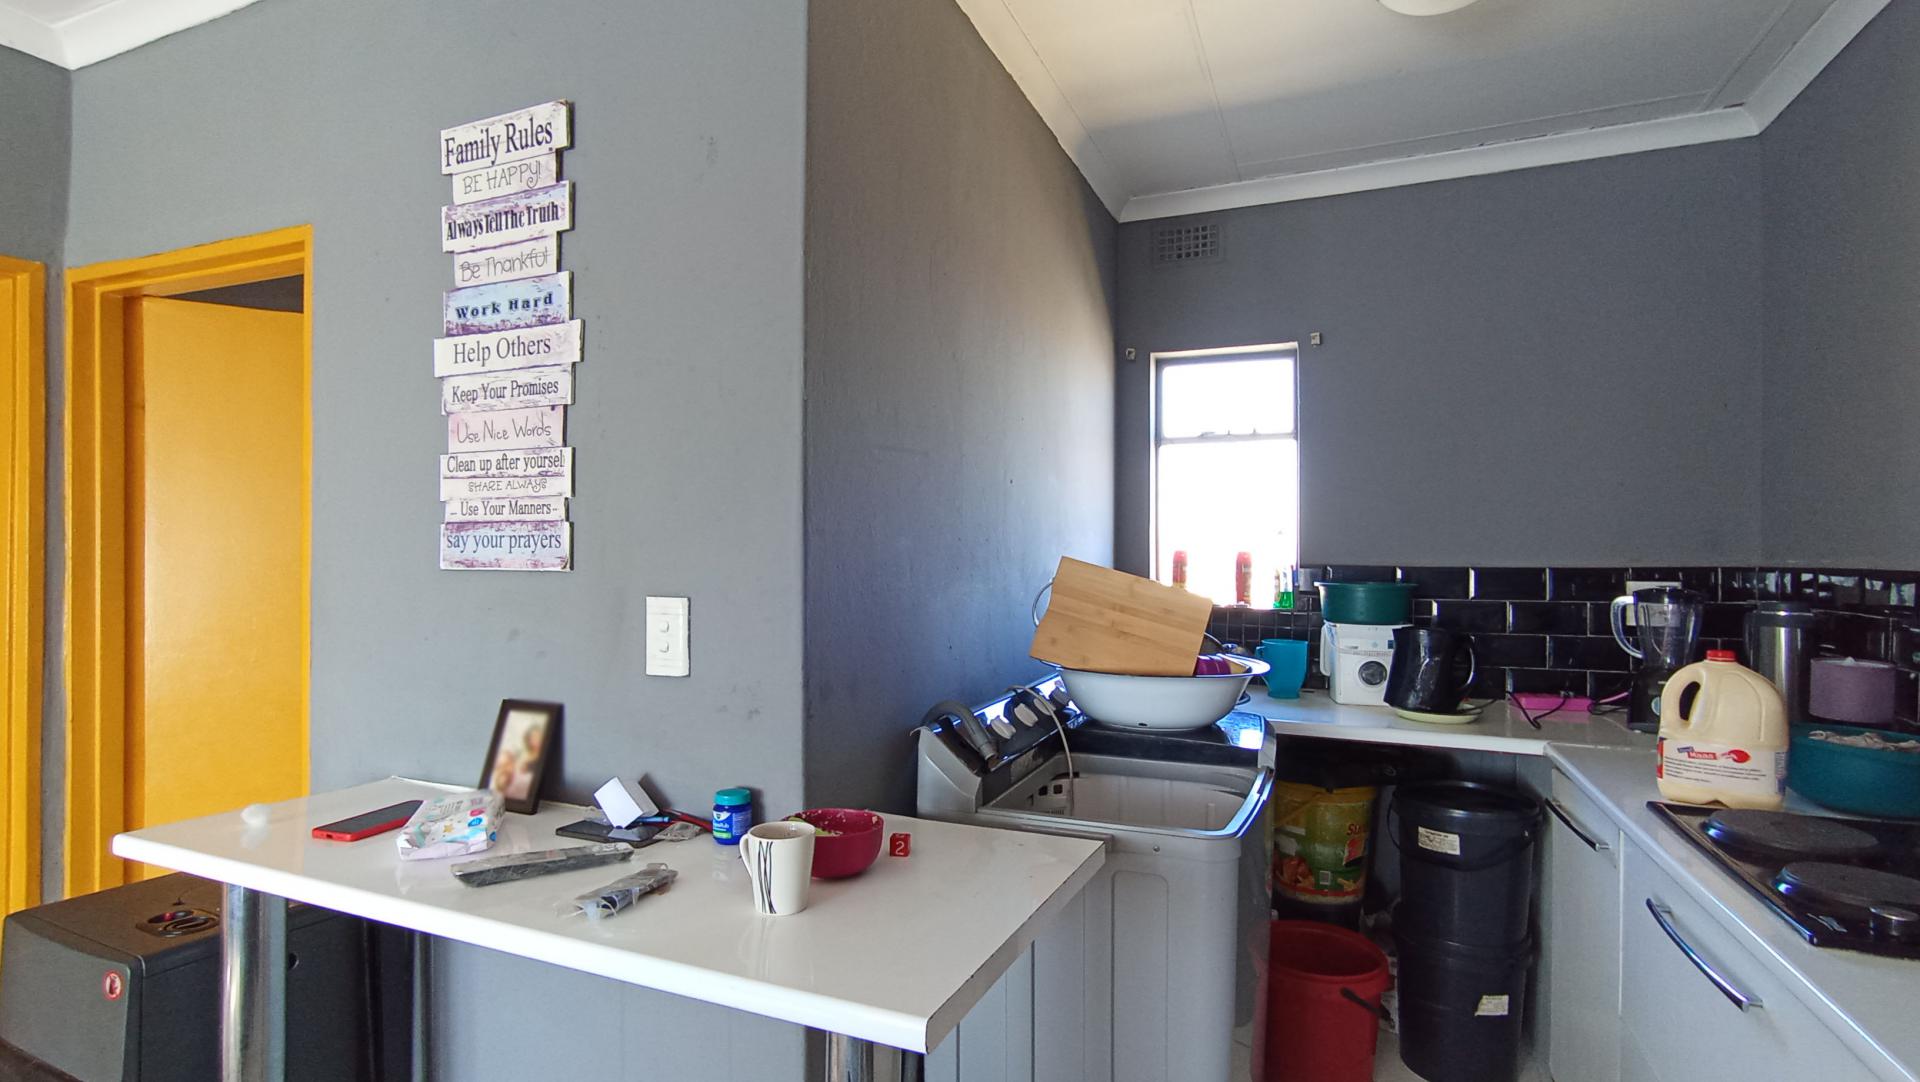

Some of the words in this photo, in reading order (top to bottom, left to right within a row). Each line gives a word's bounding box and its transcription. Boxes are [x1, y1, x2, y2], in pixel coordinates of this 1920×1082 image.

[445, 128, 501, 166] Family
[505, 117, 553, 153] Rules
[463, 173, 482, 194] BE
[486, 160, 541, 188] HAPPY!
[447, 218, 484, 240] Always
[484, 212, 502, 234] Tell
[503, 208, 525, 230] The
[526, 202, 560, 226] Truth
[460, 260, 481, 282] Be
[486, 246, 548, 276] Thankful
[455, 301, 501, 319] Work
[509, 293, 554, 311] Hard
[453, 341, 491, 367] Help
[496, 335, 551, 359] Others
[452, 385, 478, 404] Keep
[481, 382, 507, 400] Your
[510, 377, 559, 398] Promises
[456, 423, 481, 444] Use
[483, 421, 510, 440] Nice
[512, 412, 551, 438] Words
[447, 455, 476, 473] Clean
[479, 459, 492, 474] up
[495, 453, 520, 471] after
[523, 449, 564, 472] yoursel
[468, 479, 503, 493] SHARE
[504, 478, 548, 493] ALWAYS
[460, 501, 479, 516] Use
[481, 502, 506, 516] Your
[508, 500, 551, 516] Manners
[446, 534, 470, 554] say
[473, 534, 505, 554] your
[508, 532, 562, 554] prayers
[895, 840, 905, 856] 2
